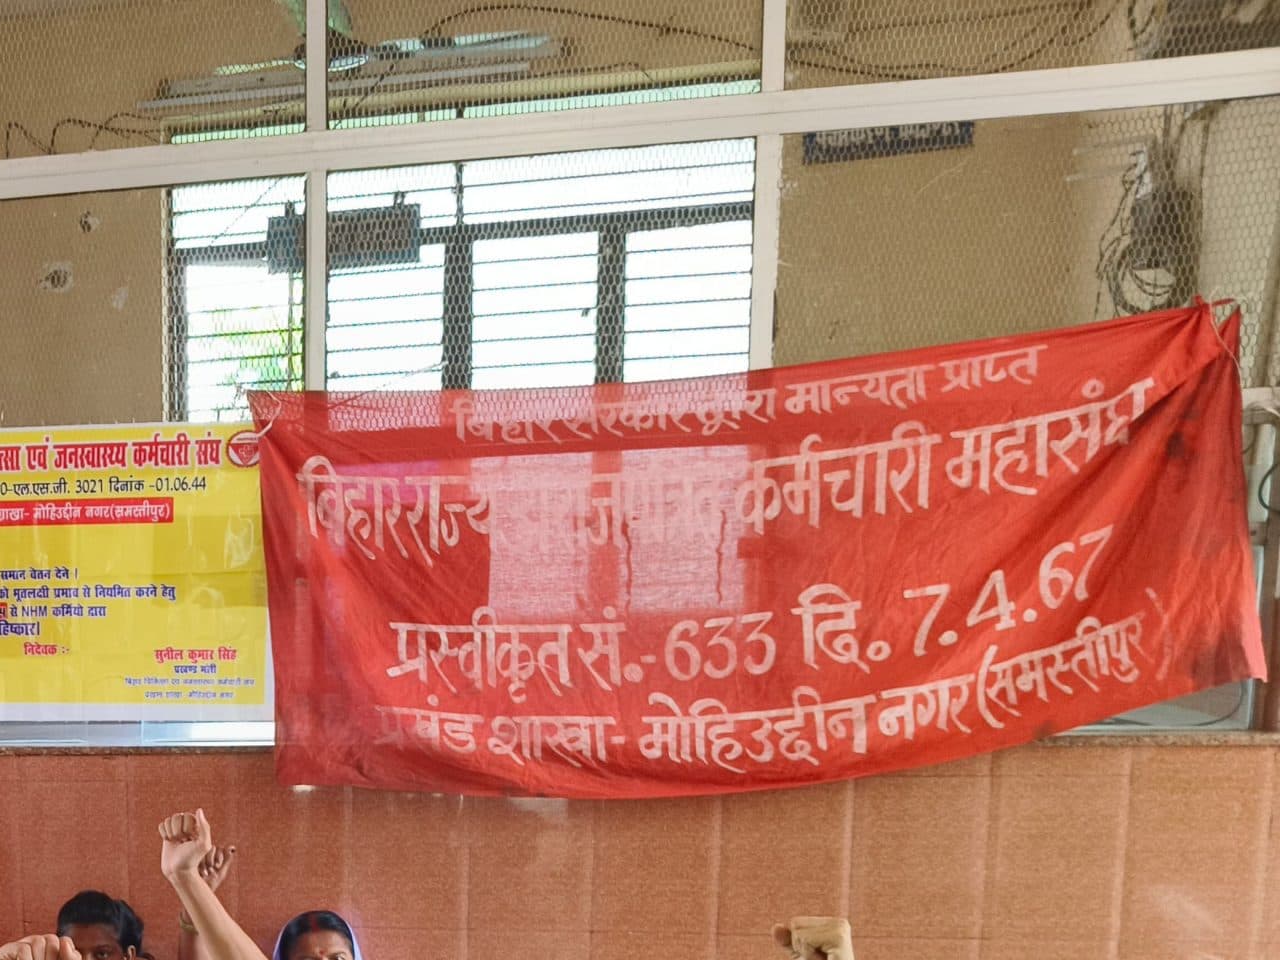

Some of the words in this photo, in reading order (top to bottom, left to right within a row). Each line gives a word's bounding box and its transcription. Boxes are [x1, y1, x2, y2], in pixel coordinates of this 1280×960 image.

[784, 364, 936, 415] मान्यता
[939, 344, 1049, 393] प्राप्त
[26, 437, 49, 470] एवं
[132, 433, 190, 467] कर्मचारी
[195, 432, 221, 465] संघ
[734, 420, 942, 536] कर्मचारी
[945, 378, 1155, 496] महासंघ
[75, 479, 103, 494] 3021
[109, 475, 145, 492] दिनांक
[0, 569, 26, 580] समान
[82, 584, 90, 598] से
[161, 584, 176, 600] हेतु
[21, 605, 48, 617] NHM
[187, 649, 214, 663] कुमार
[386, 606, 573, 703] प्रस्वीकृत
[639, 686, 877, 773] मोहिउद्दीन
